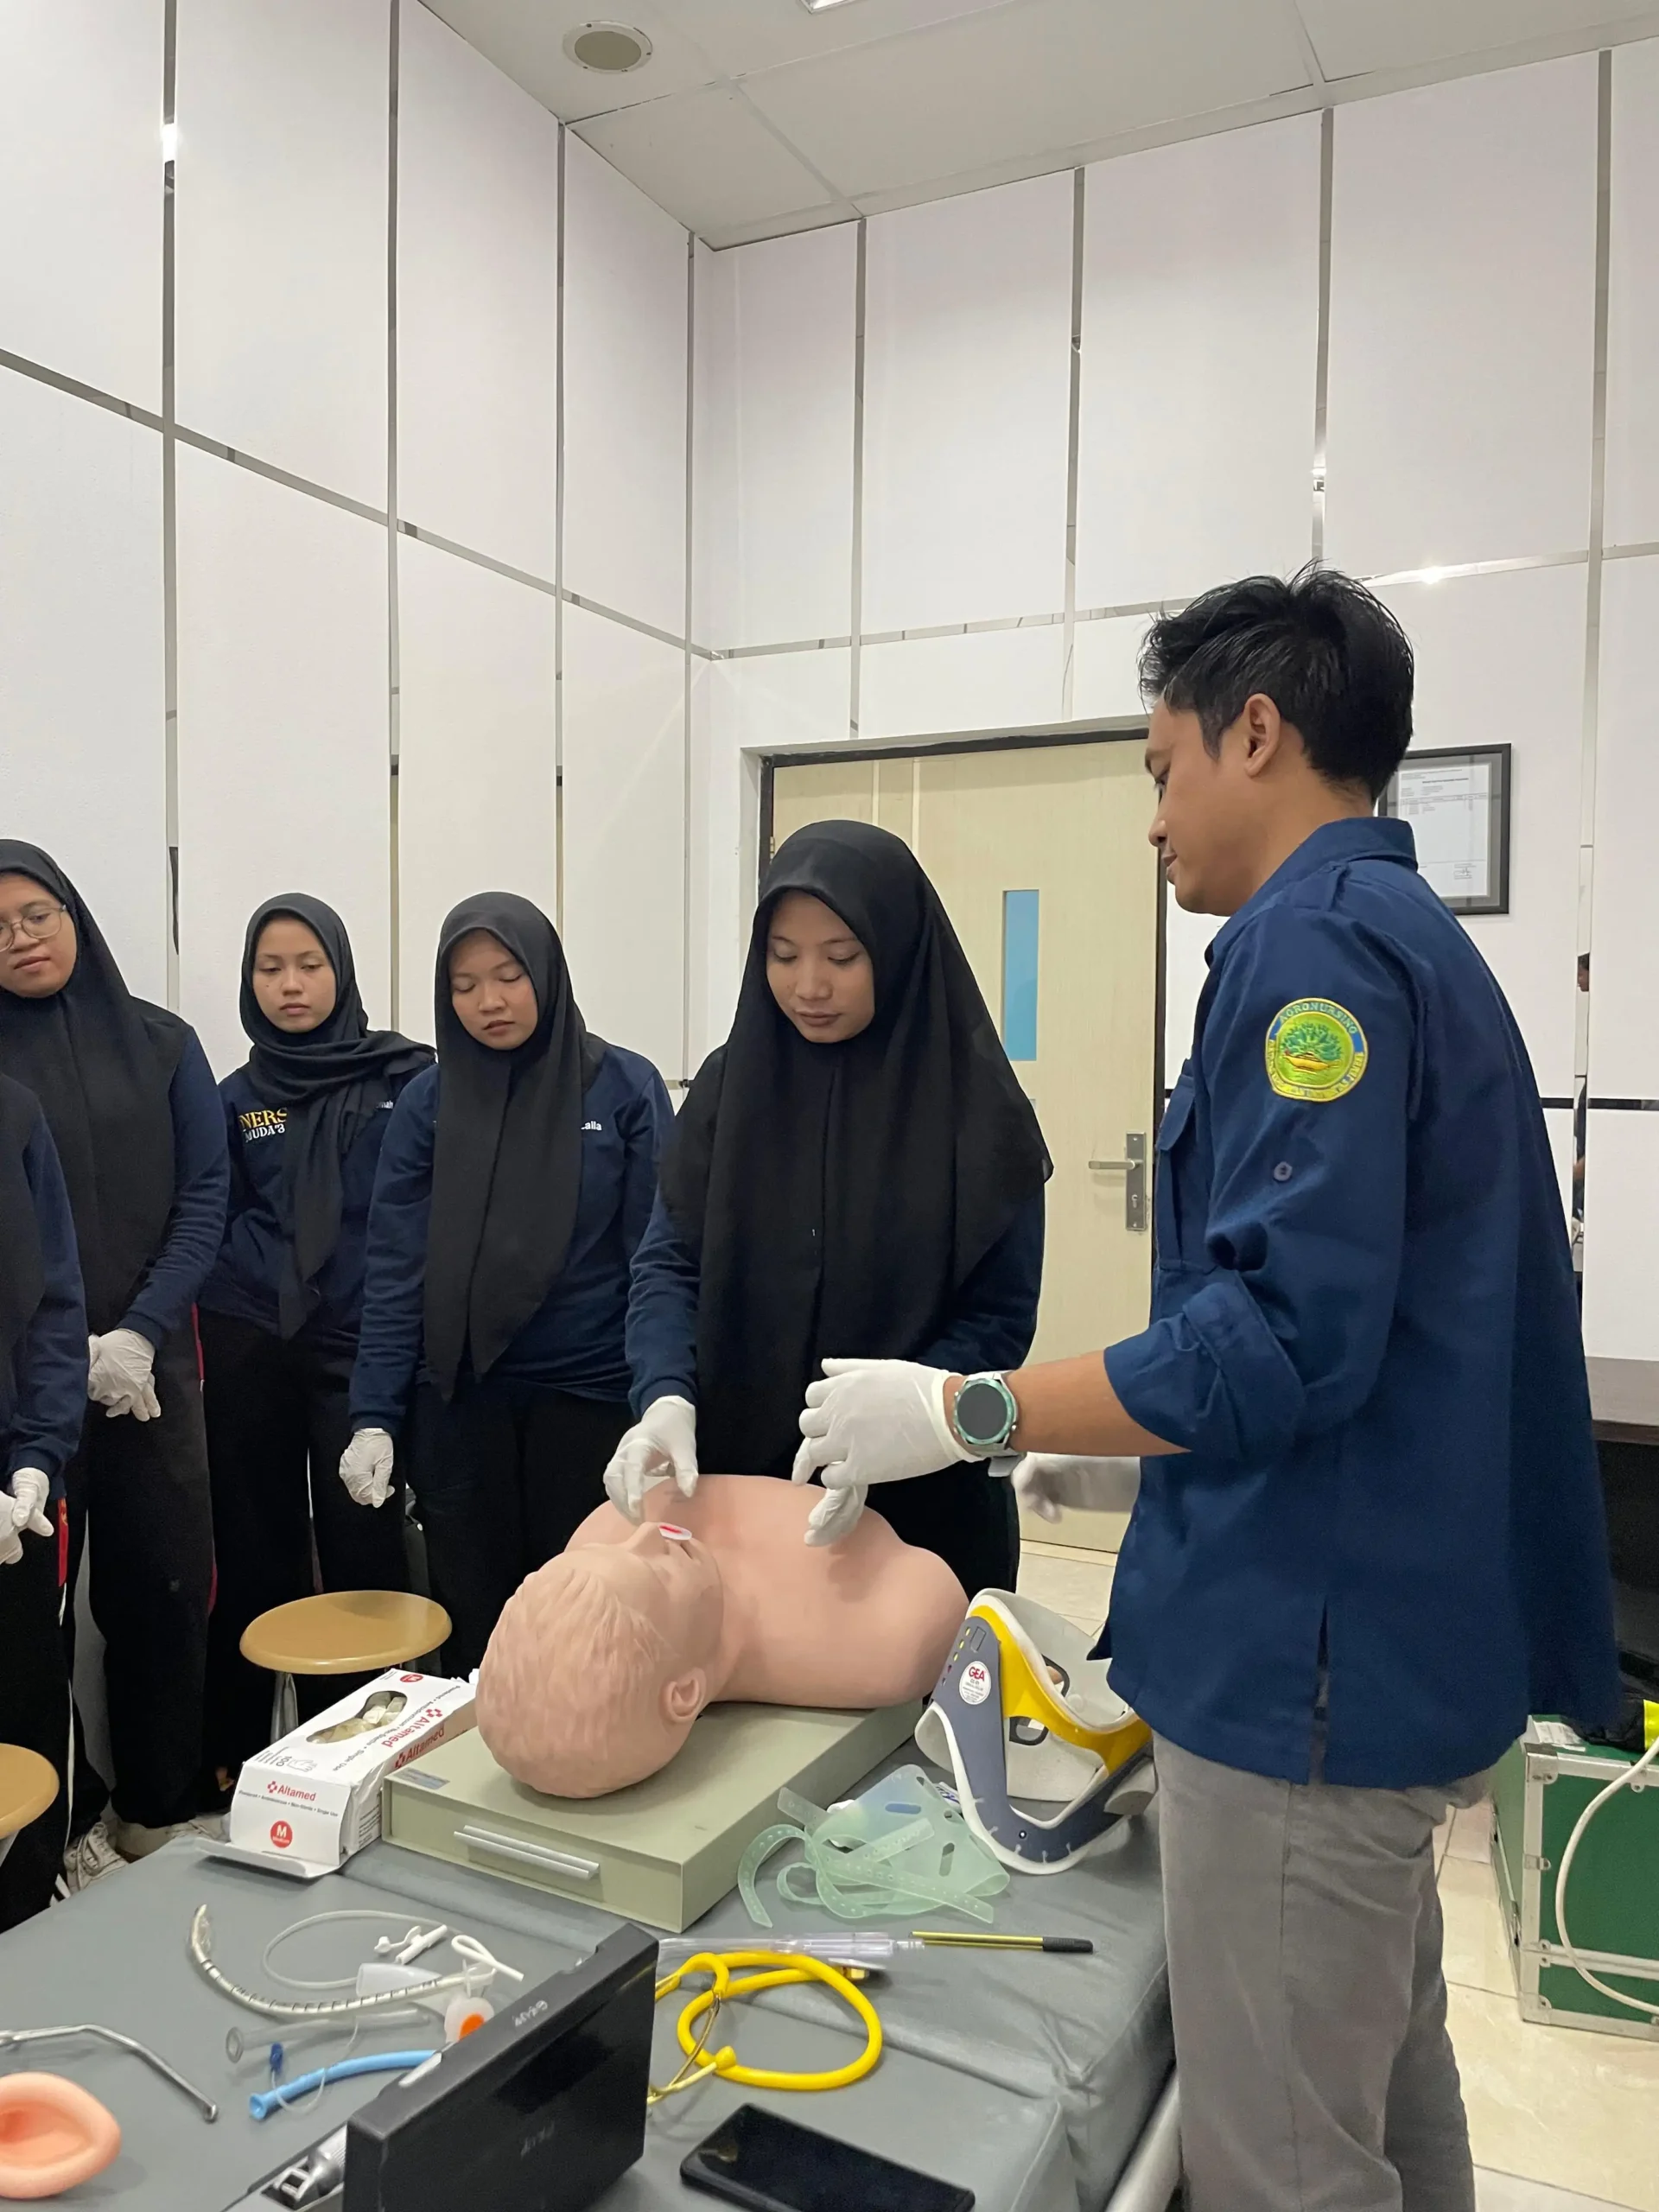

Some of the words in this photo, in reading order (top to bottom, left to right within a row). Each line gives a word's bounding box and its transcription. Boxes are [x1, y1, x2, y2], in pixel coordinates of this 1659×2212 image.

[238, 1107, 289, 1128] NERS
[969, 1666, 985, 1682] GEA
[381, 1716, 430, 1748] Altamed
[405, 1722, 445, 1762] Altamed
[277, 1784, 316, 1802] Altamed
[276, 1824, 288, 1838] M
